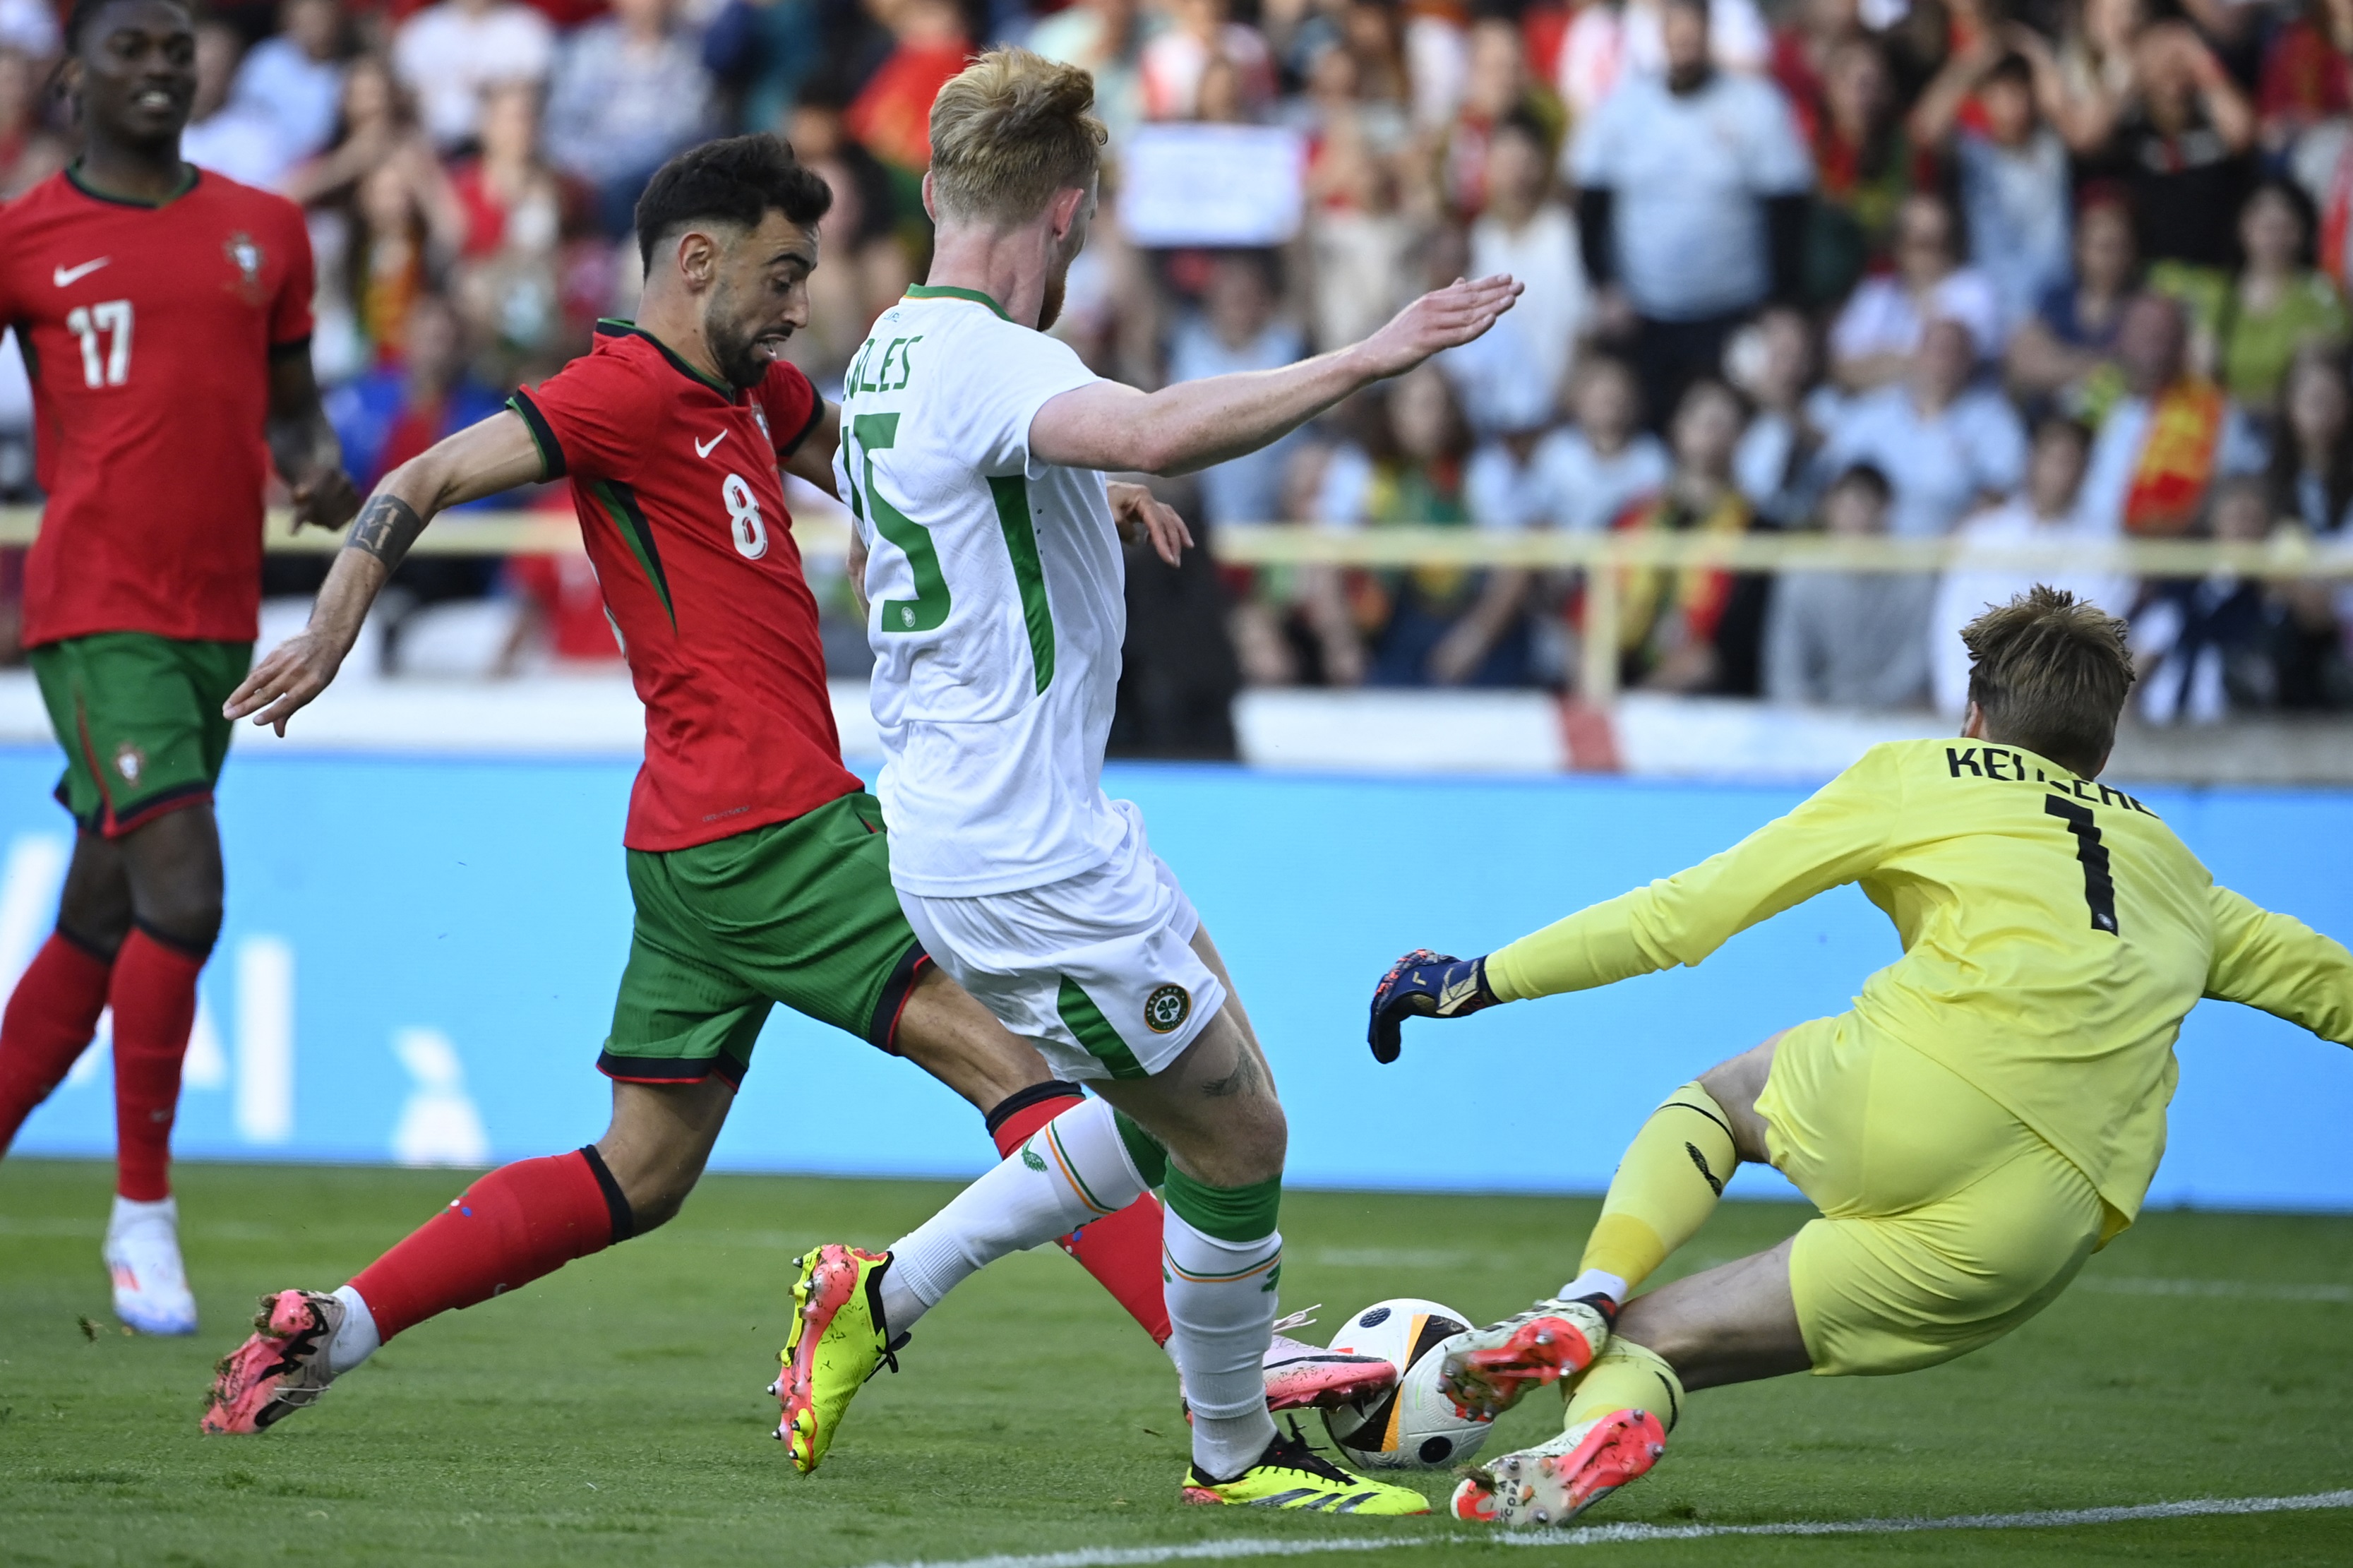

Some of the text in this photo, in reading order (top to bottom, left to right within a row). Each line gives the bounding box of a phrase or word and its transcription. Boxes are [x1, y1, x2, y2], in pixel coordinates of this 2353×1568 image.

[67, 299, 134, 388] 17
[843, 335, 923, 402] ALES
[722, 473, 767, 560] 8
[842, 412, 951, 632] 15
[2044, 793, 2118, 937] 1
